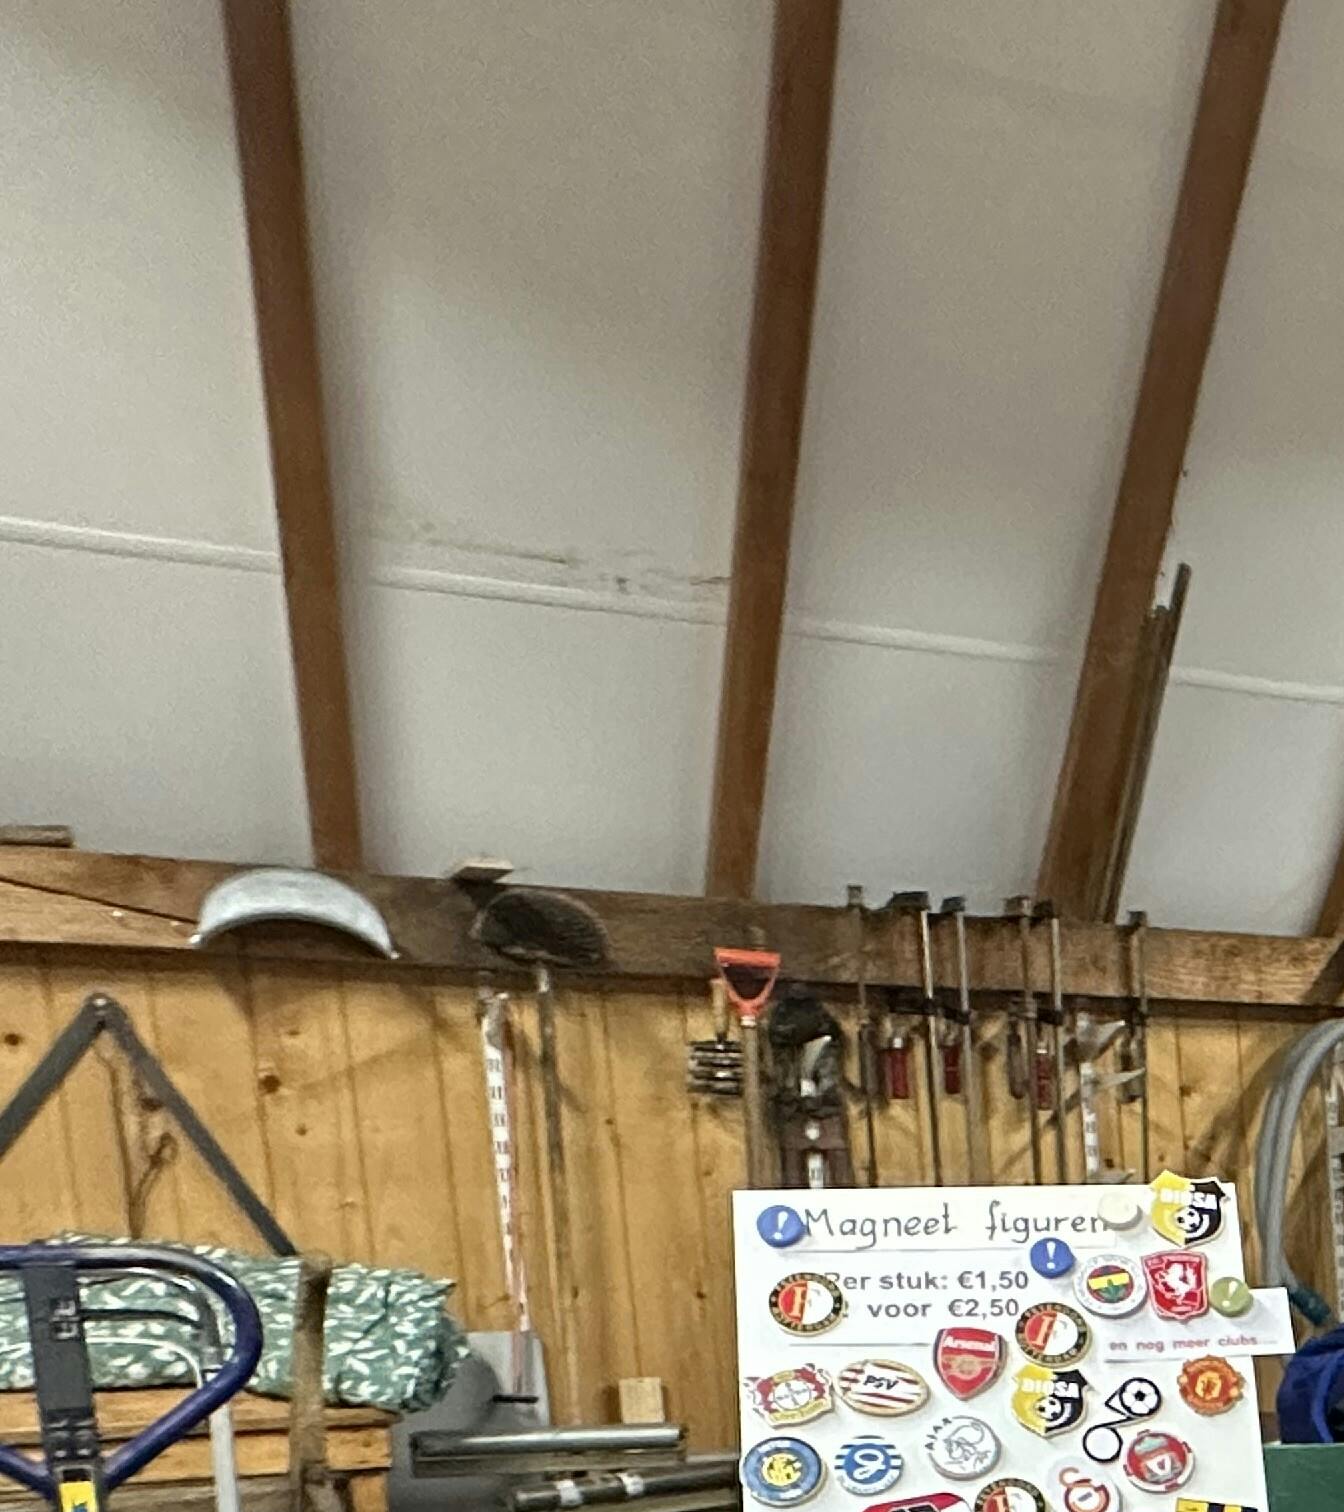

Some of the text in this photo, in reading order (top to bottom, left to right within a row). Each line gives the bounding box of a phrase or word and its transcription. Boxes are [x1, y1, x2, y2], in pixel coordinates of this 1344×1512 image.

[804, 1202, 958, 1250] Magneet
[879, 1271, 948, 1290] stuk:
[957, 1270, 1029, 1293] €1,50
[867, 1302, 932, 1319] voor
[948, 1298, 1020, 1322] €2,50
[1109, 1340, 1128, 1351] en
[1136, 1339, 1165, 1353] nog
[1173, 1337, 1210, 1349] meer
[863, 1374, 900, 1391] PSV
[924, 1416, 953, 1451] AJAX
